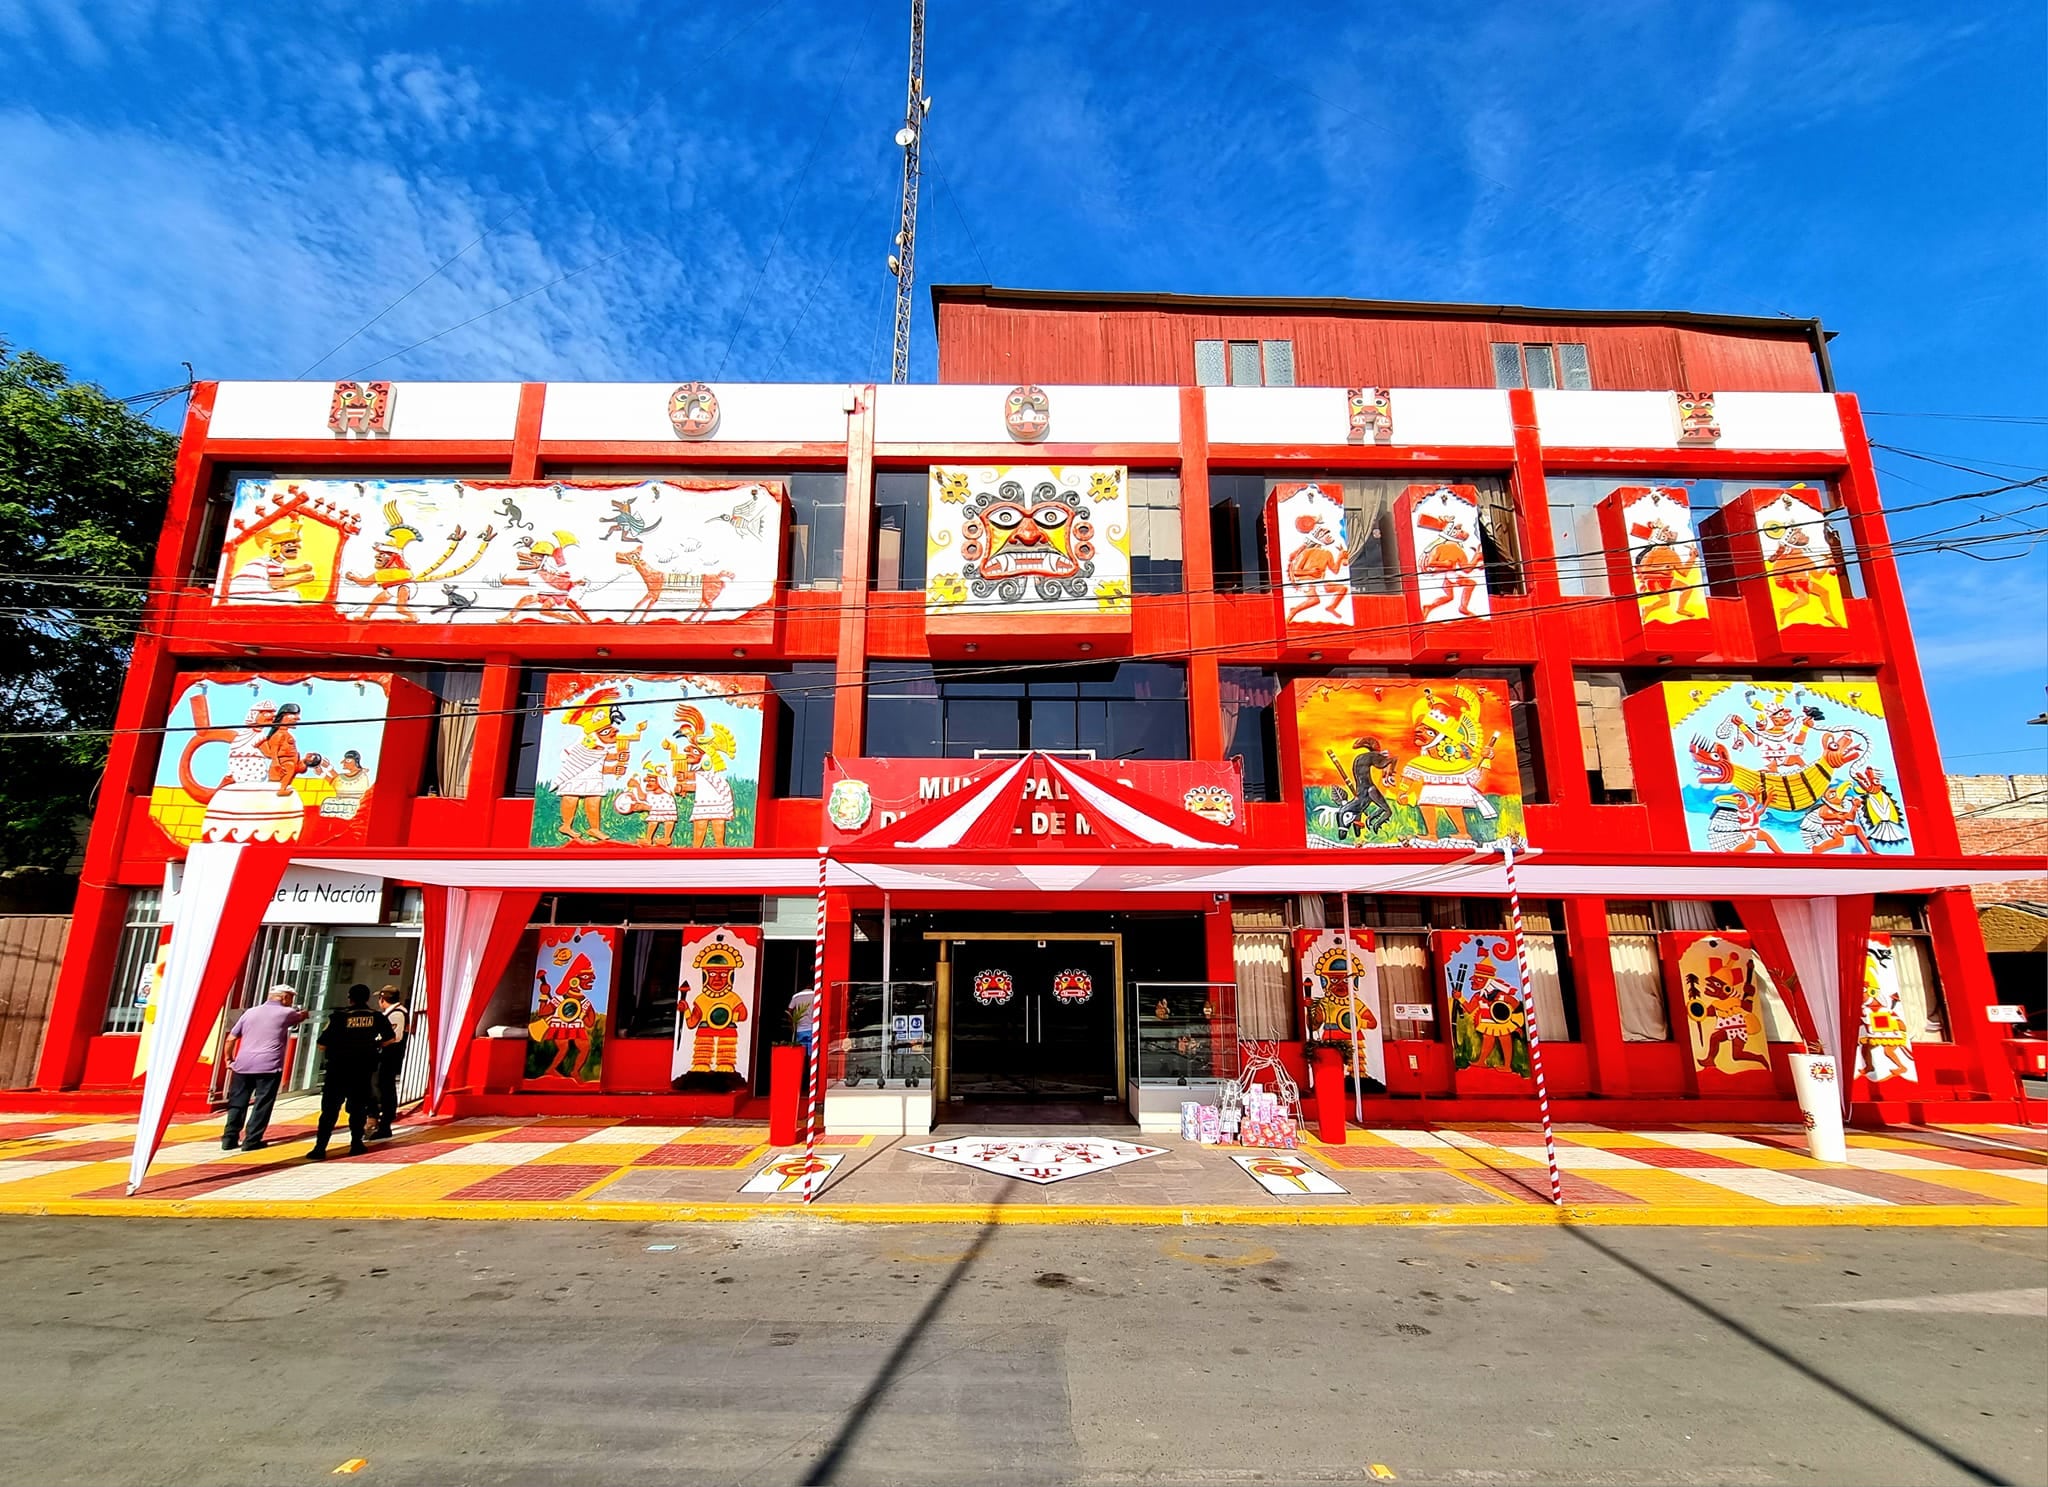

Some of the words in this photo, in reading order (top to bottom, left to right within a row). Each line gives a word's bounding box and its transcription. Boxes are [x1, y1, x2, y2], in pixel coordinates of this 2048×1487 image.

[1031, 812, 1066, 835] DE
[271, 887, 287, 903] e
[292, 883, 309, 903] la
[314, 883, 376, 903] Nación
